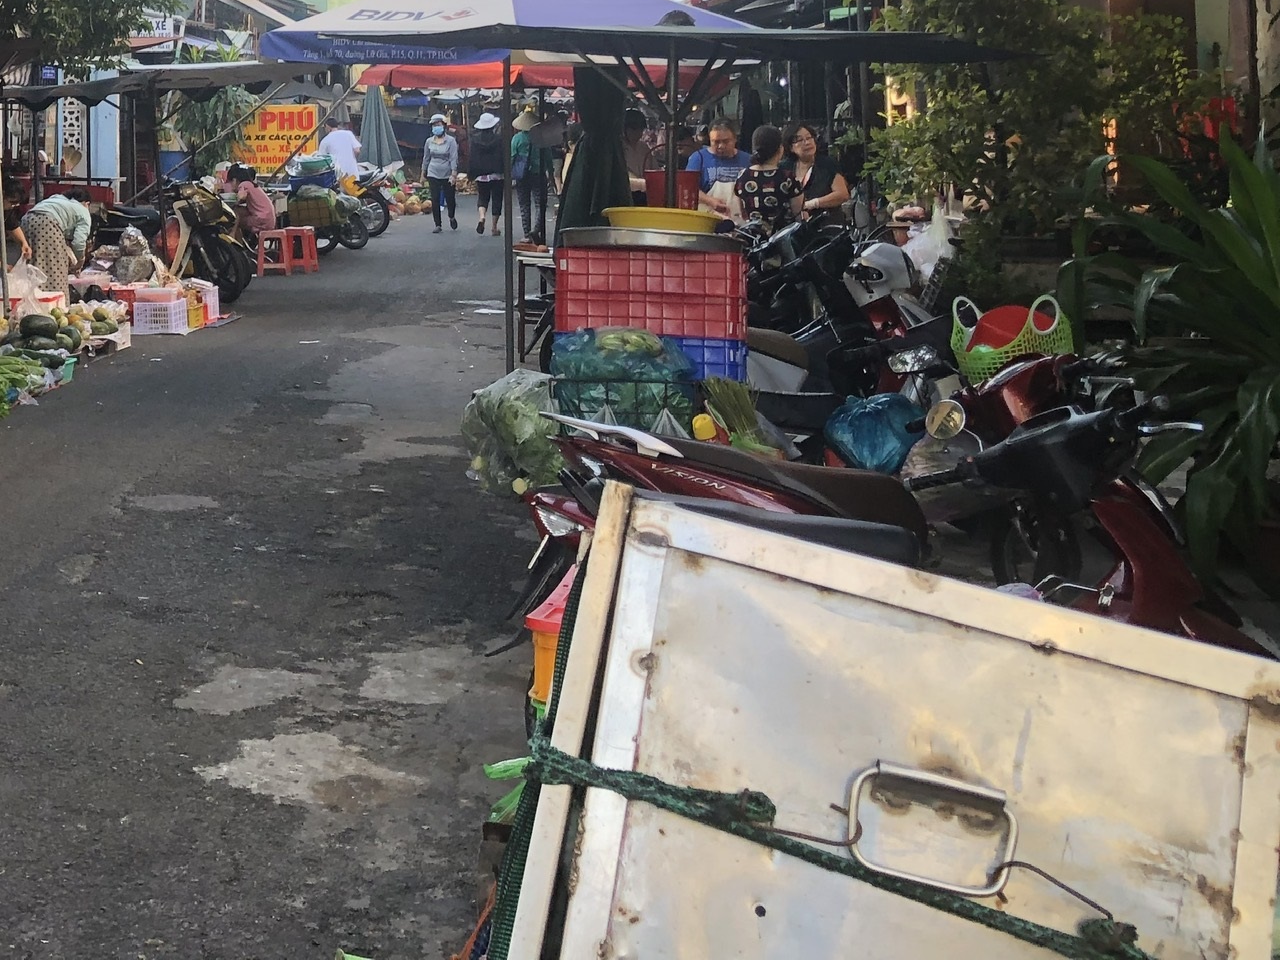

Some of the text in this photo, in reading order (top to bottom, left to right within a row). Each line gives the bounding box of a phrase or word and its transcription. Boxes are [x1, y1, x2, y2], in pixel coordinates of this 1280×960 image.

[347, 9, 443, 21] BIDV
[259, 106, 314, 131] PHÚ
[651, 463, 726, 490] VISION
